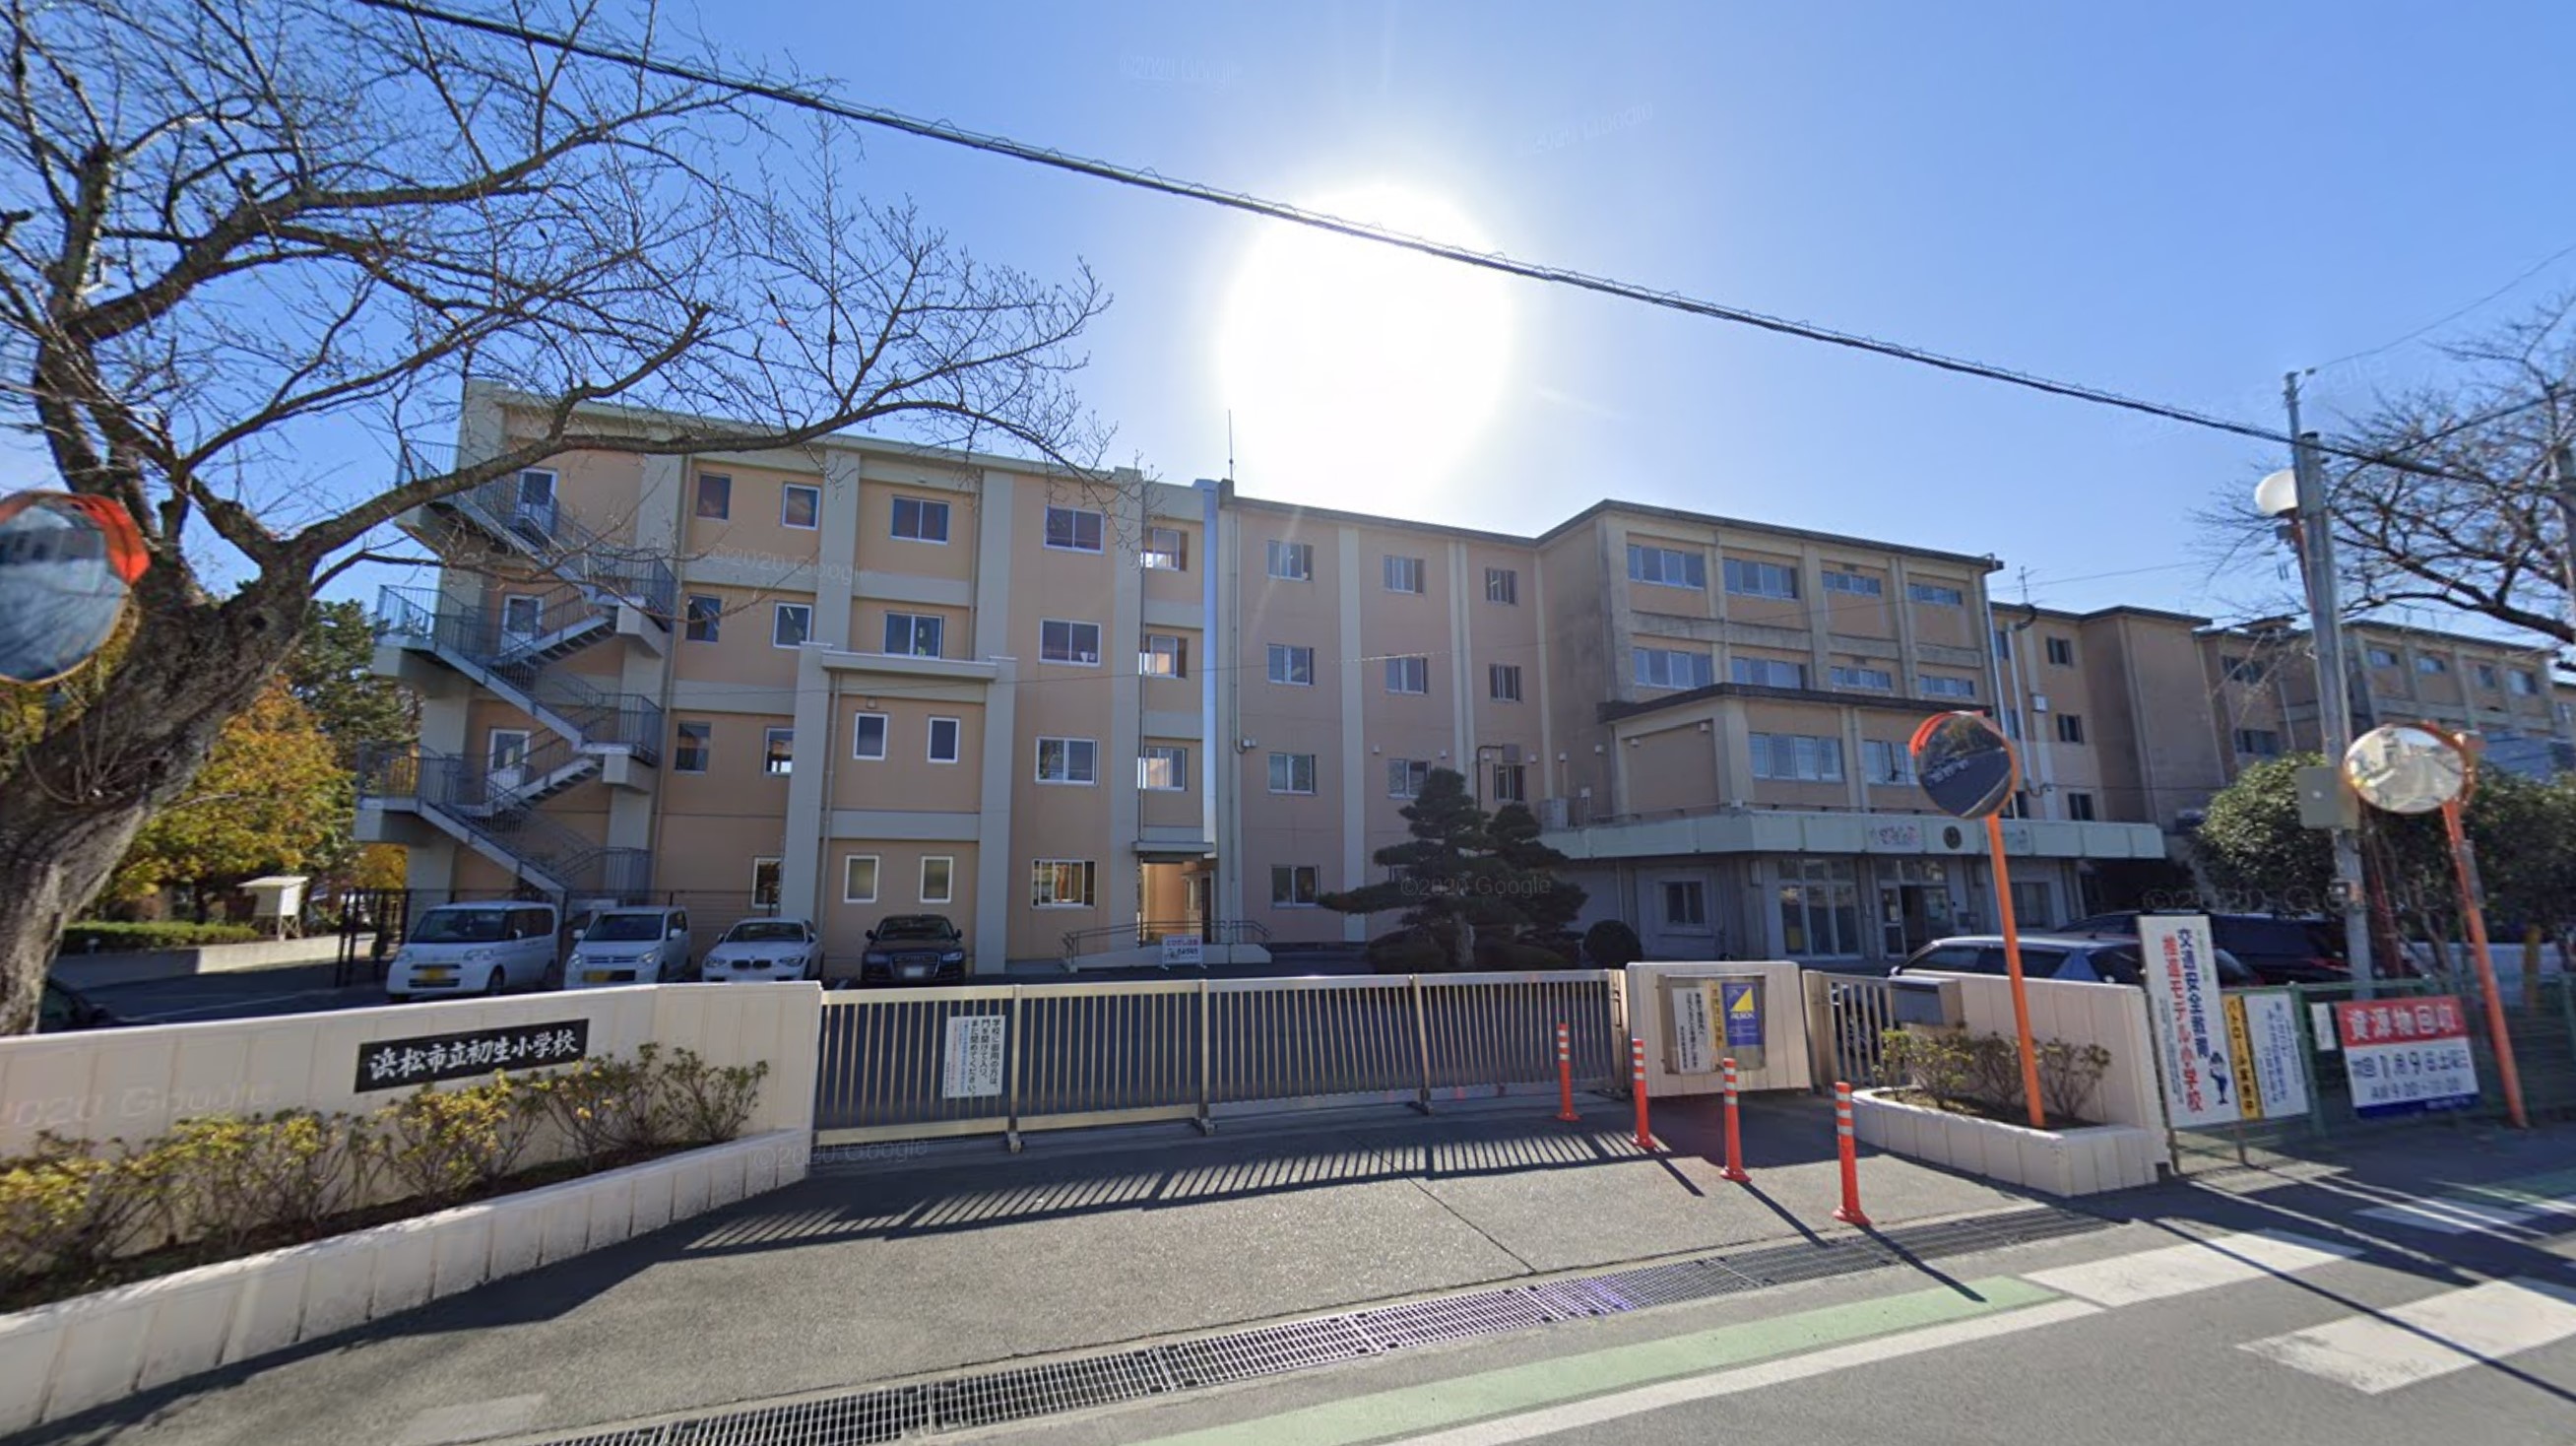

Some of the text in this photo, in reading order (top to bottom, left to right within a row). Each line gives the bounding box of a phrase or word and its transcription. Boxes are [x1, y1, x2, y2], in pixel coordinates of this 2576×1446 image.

[2161, 934, 2203, 1112] 推進モデル小学校
[2177, 928, 2209, 1058] 交通安全教育
[2346, 1004, 2457, 1041] 資源物回収
[369, 1029, 578, 1080] 浜松市立初生小学校
